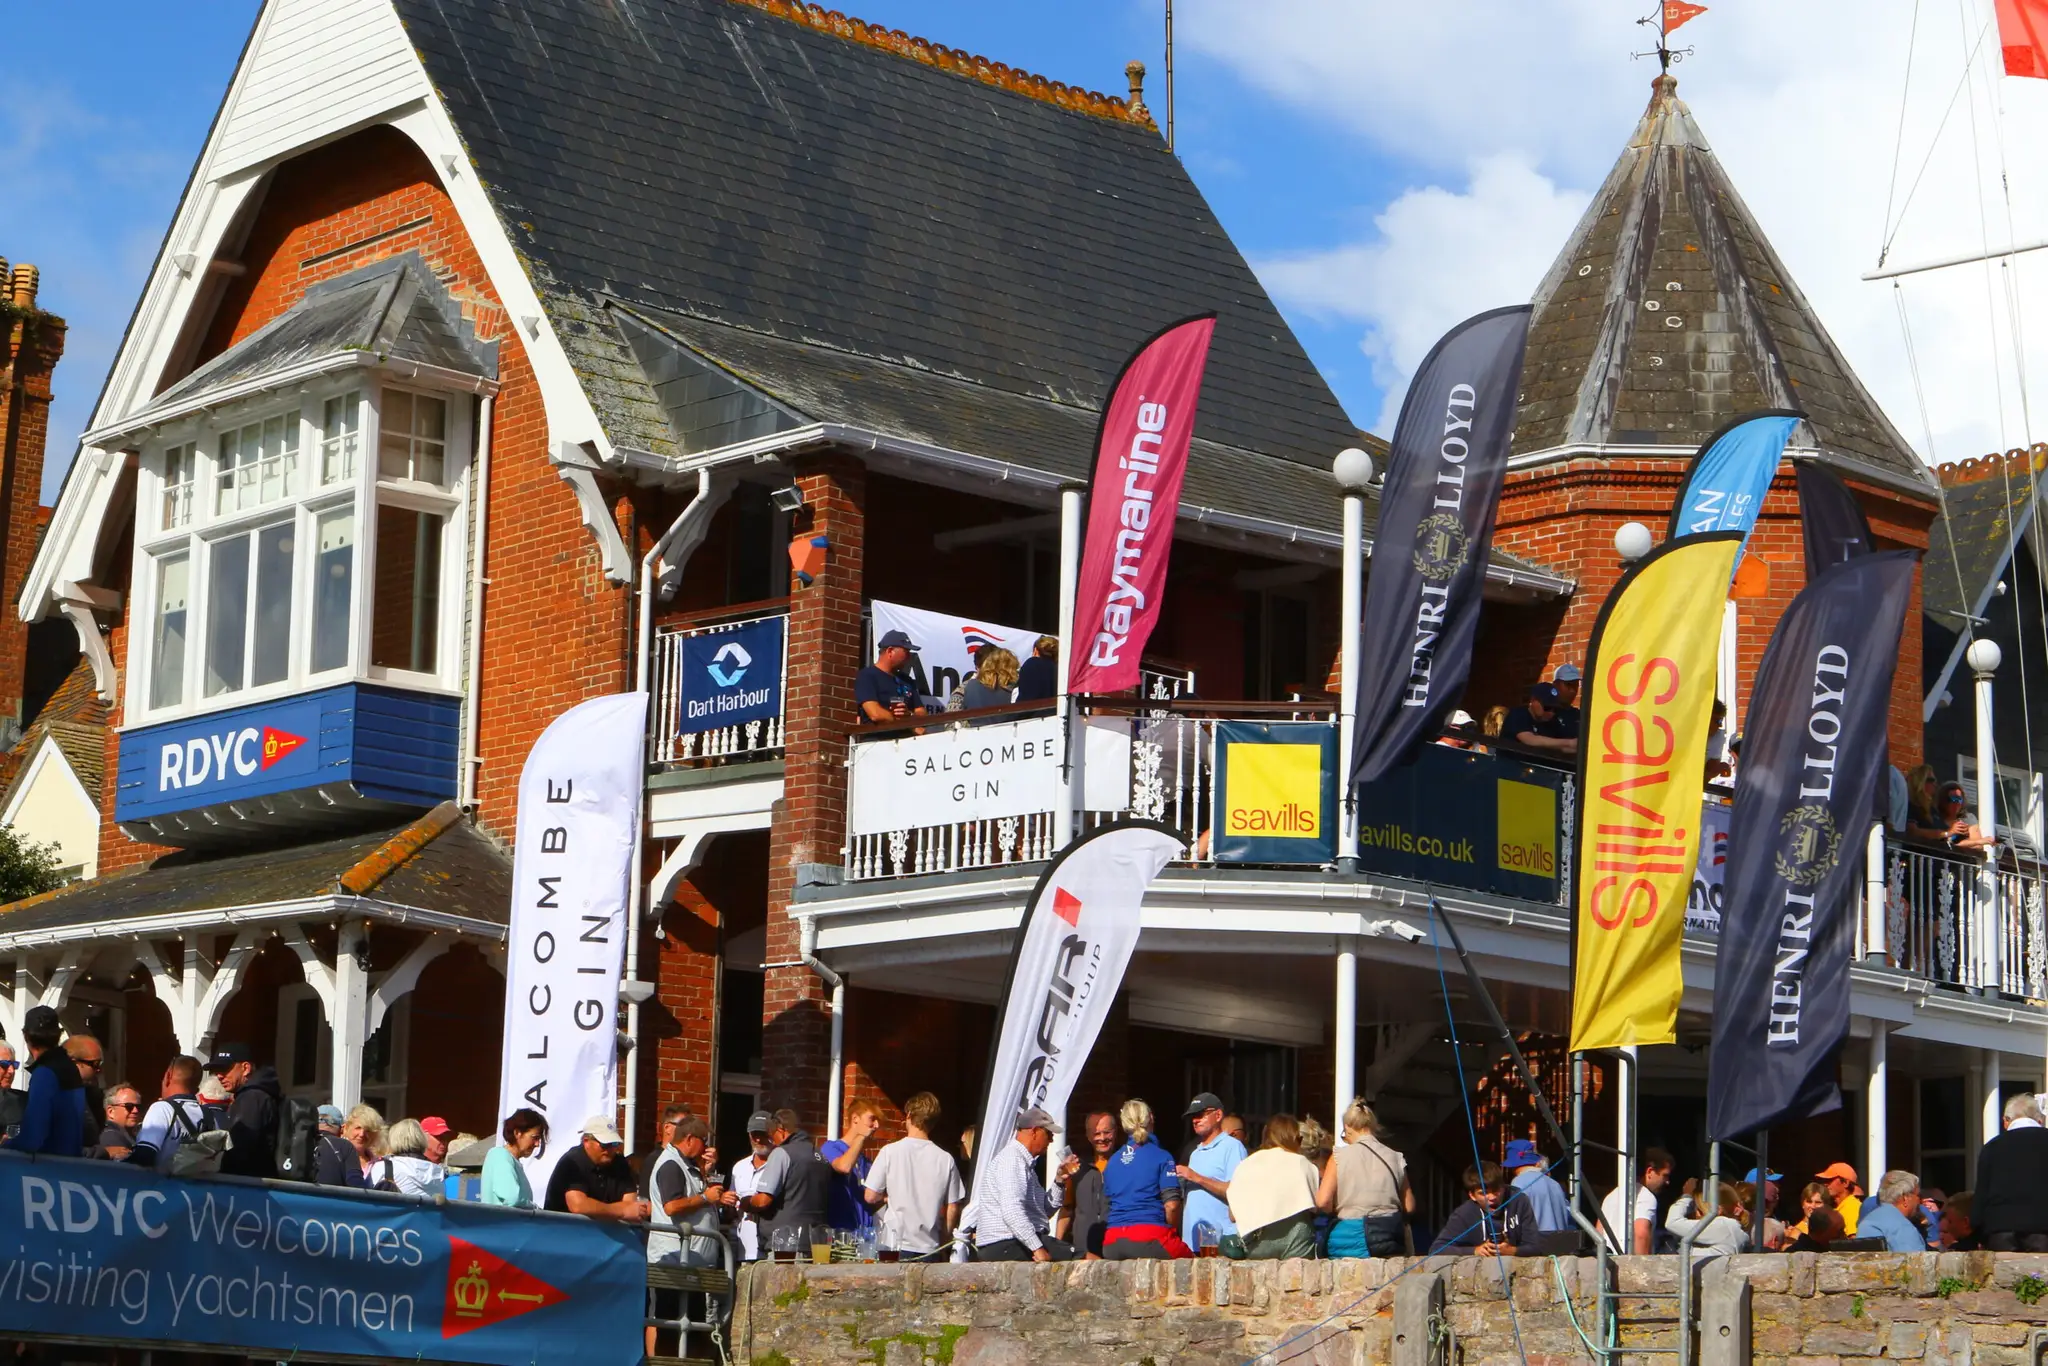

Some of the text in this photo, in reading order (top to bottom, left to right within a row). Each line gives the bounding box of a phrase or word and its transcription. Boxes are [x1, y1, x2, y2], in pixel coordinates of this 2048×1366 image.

[1090, 400, 1167, 667] Raymarine
[1402, 383, 1476, 708] HENRI LLOYD
[688, 688, 770, 718] Dart Harbour
[160, 727, 259, 791] RDYC
[905, 738, 1054, 776] SALCOMBE
[952, 779, 999, 801] GIN
[1231, 804, 1315, 832] savills
[1590, 653, 1686, 930] savills
[1358, 823, 1475, 863] avills.co.uk
[1501, 842, 1554, 873] savills
[1767, 644, 1848, 1045] HENRI LLOYD
[574, 915, 611, 1031] GIN
[282, 1157, 292, 1170] 6
[21, 1175, 423, 1267] RDYC Welcomes
[166, 1265, 415, 1333] yachtsmen
